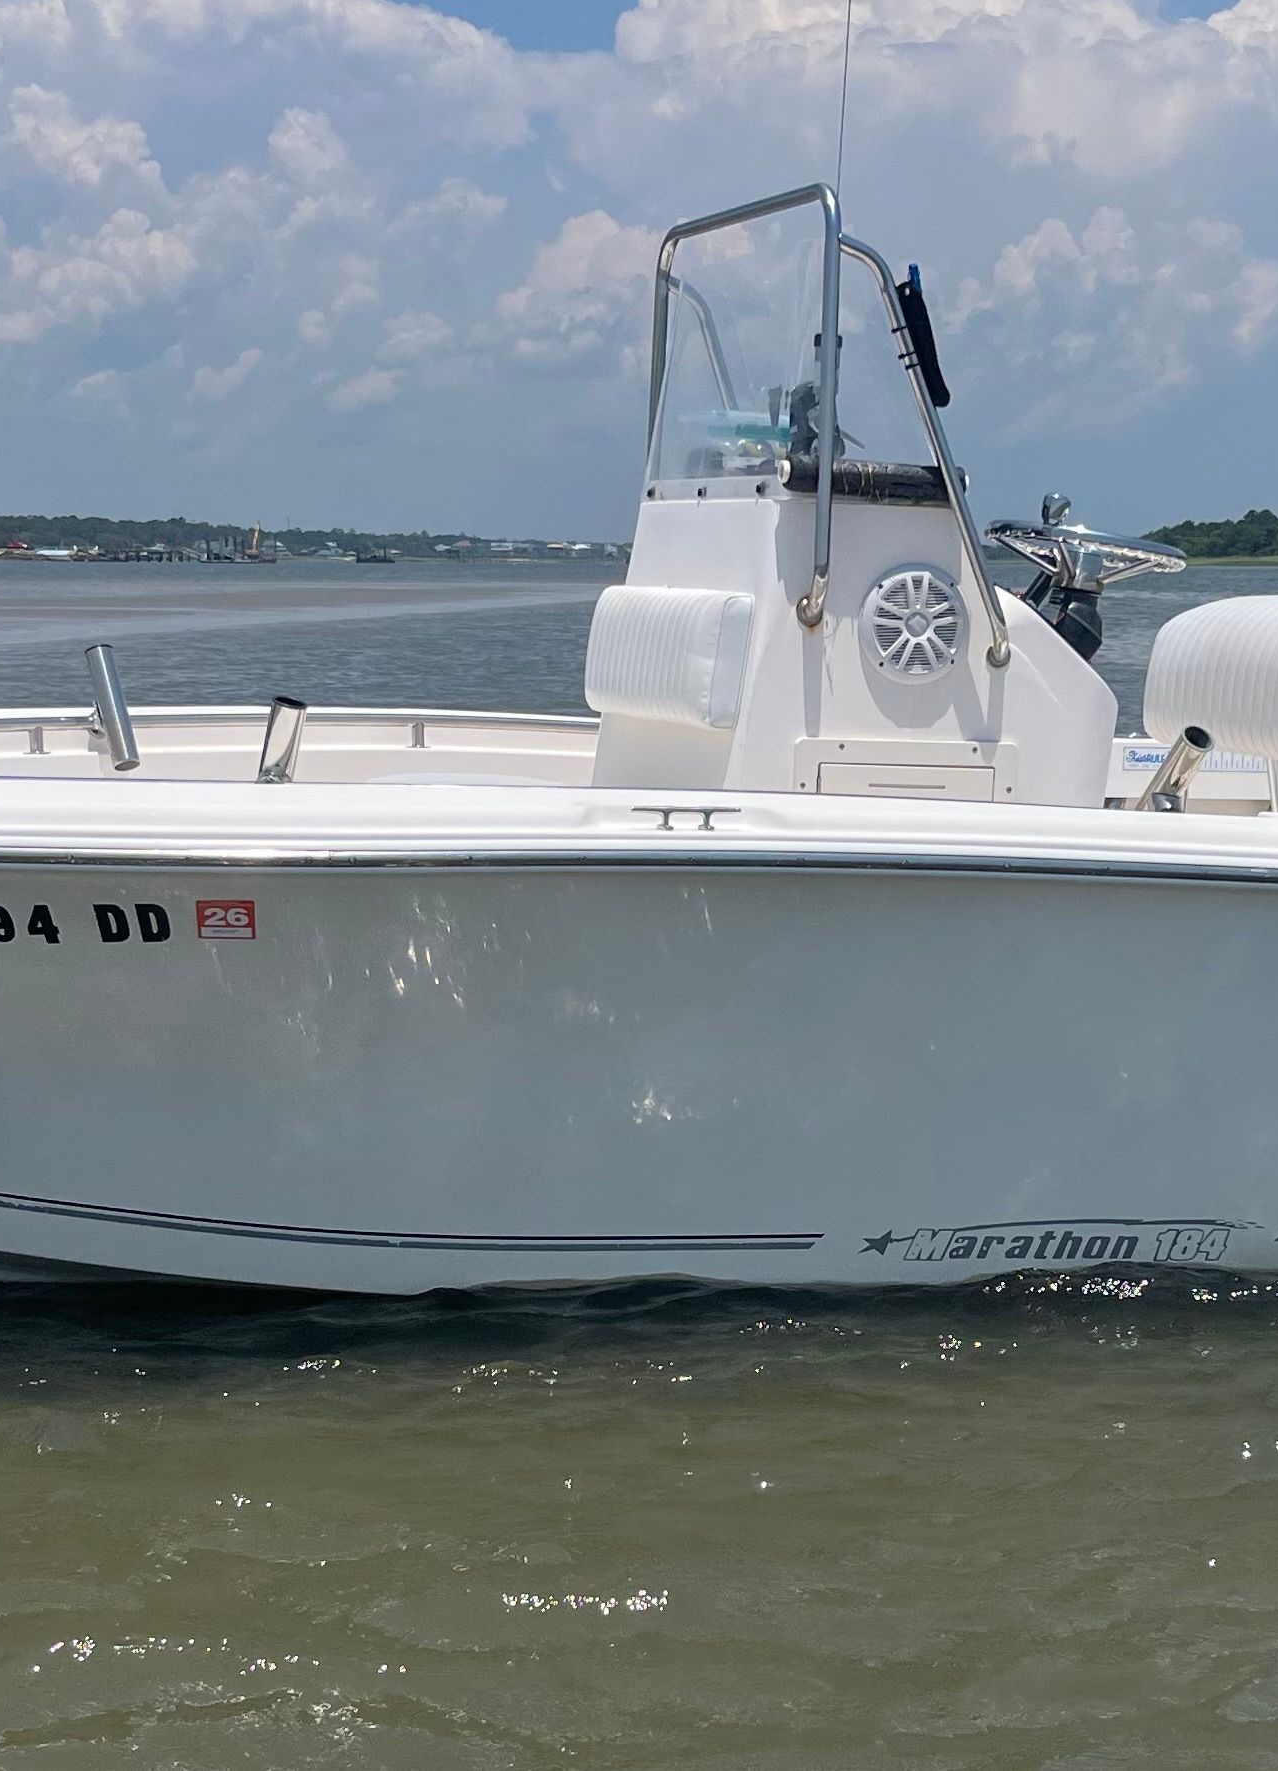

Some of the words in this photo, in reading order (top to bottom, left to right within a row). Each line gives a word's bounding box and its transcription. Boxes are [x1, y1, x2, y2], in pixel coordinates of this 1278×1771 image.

[93, 903, 171, 943] DD
[204, 907, 249, 927] 26
[903, 1228, 1139, 1262] Marathon
[1153, 1228, 1231, 1262] 184
